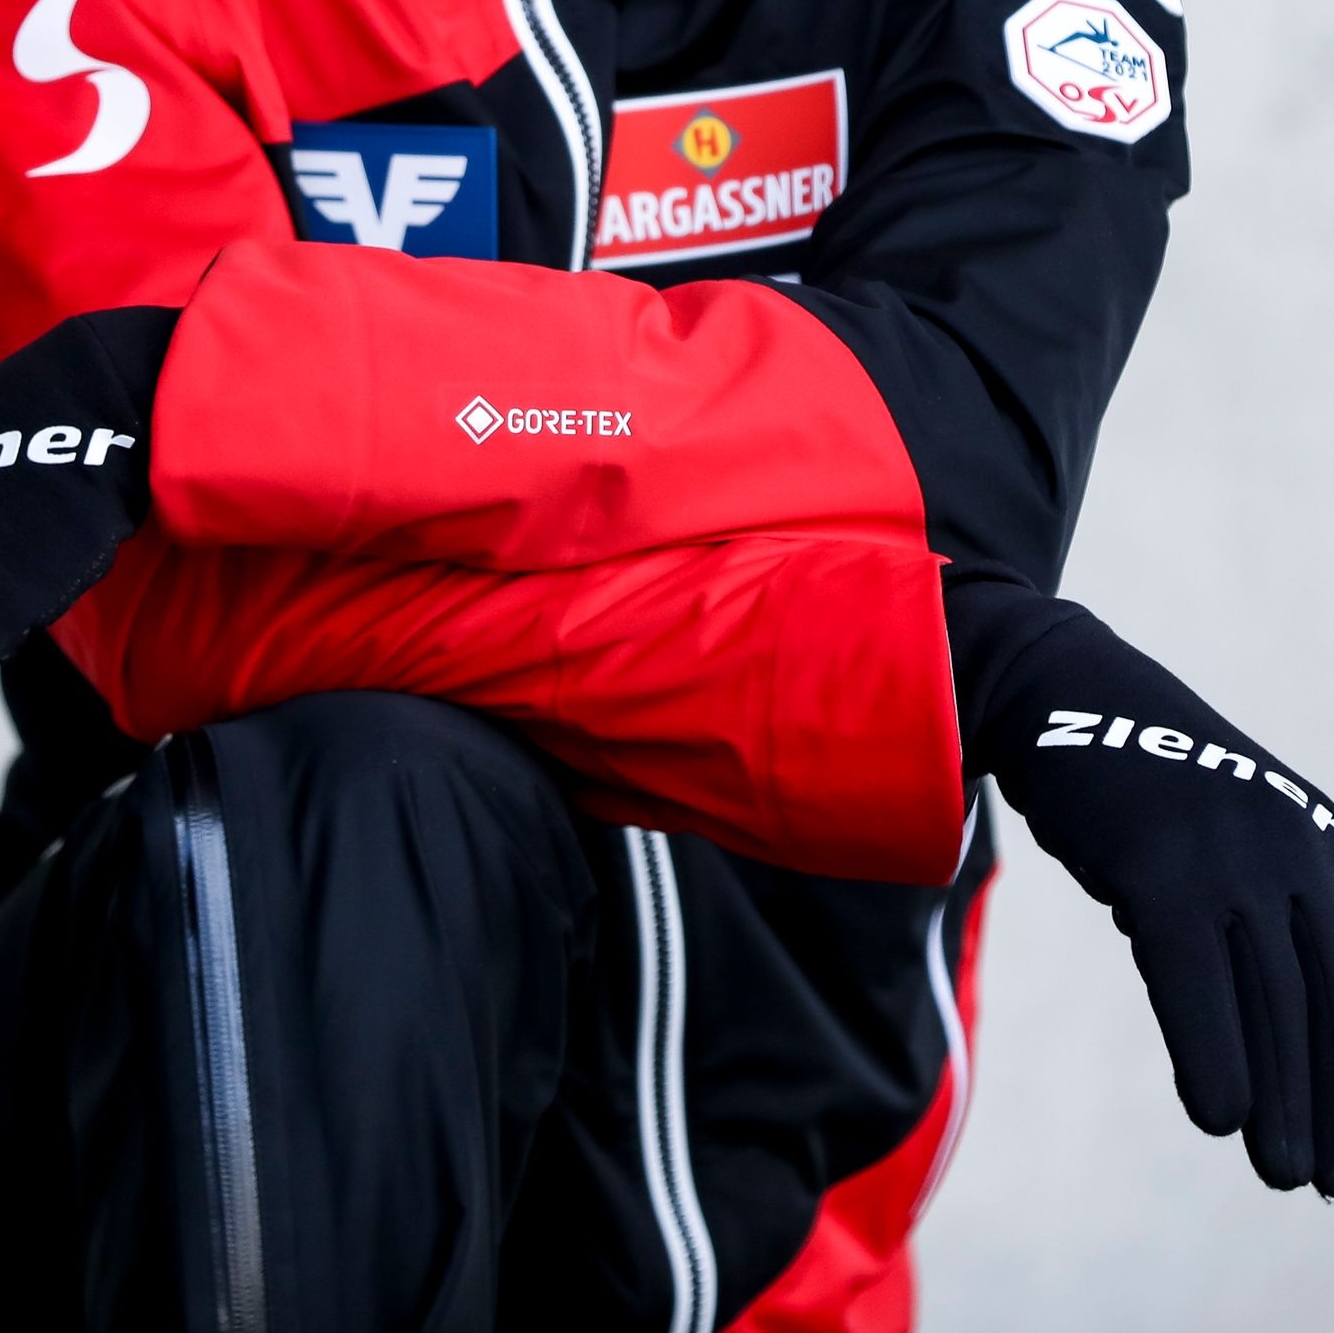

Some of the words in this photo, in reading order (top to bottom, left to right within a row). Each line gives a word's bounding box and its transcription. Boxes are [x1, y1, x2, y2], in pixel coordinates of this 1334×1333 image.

[1099, 47, 1146, 68] TEAM
[1101, 61, 1148, 82] 2021
[693, 127, 720, 157] H
[595, 163, 834, 247] ARGASSNER
